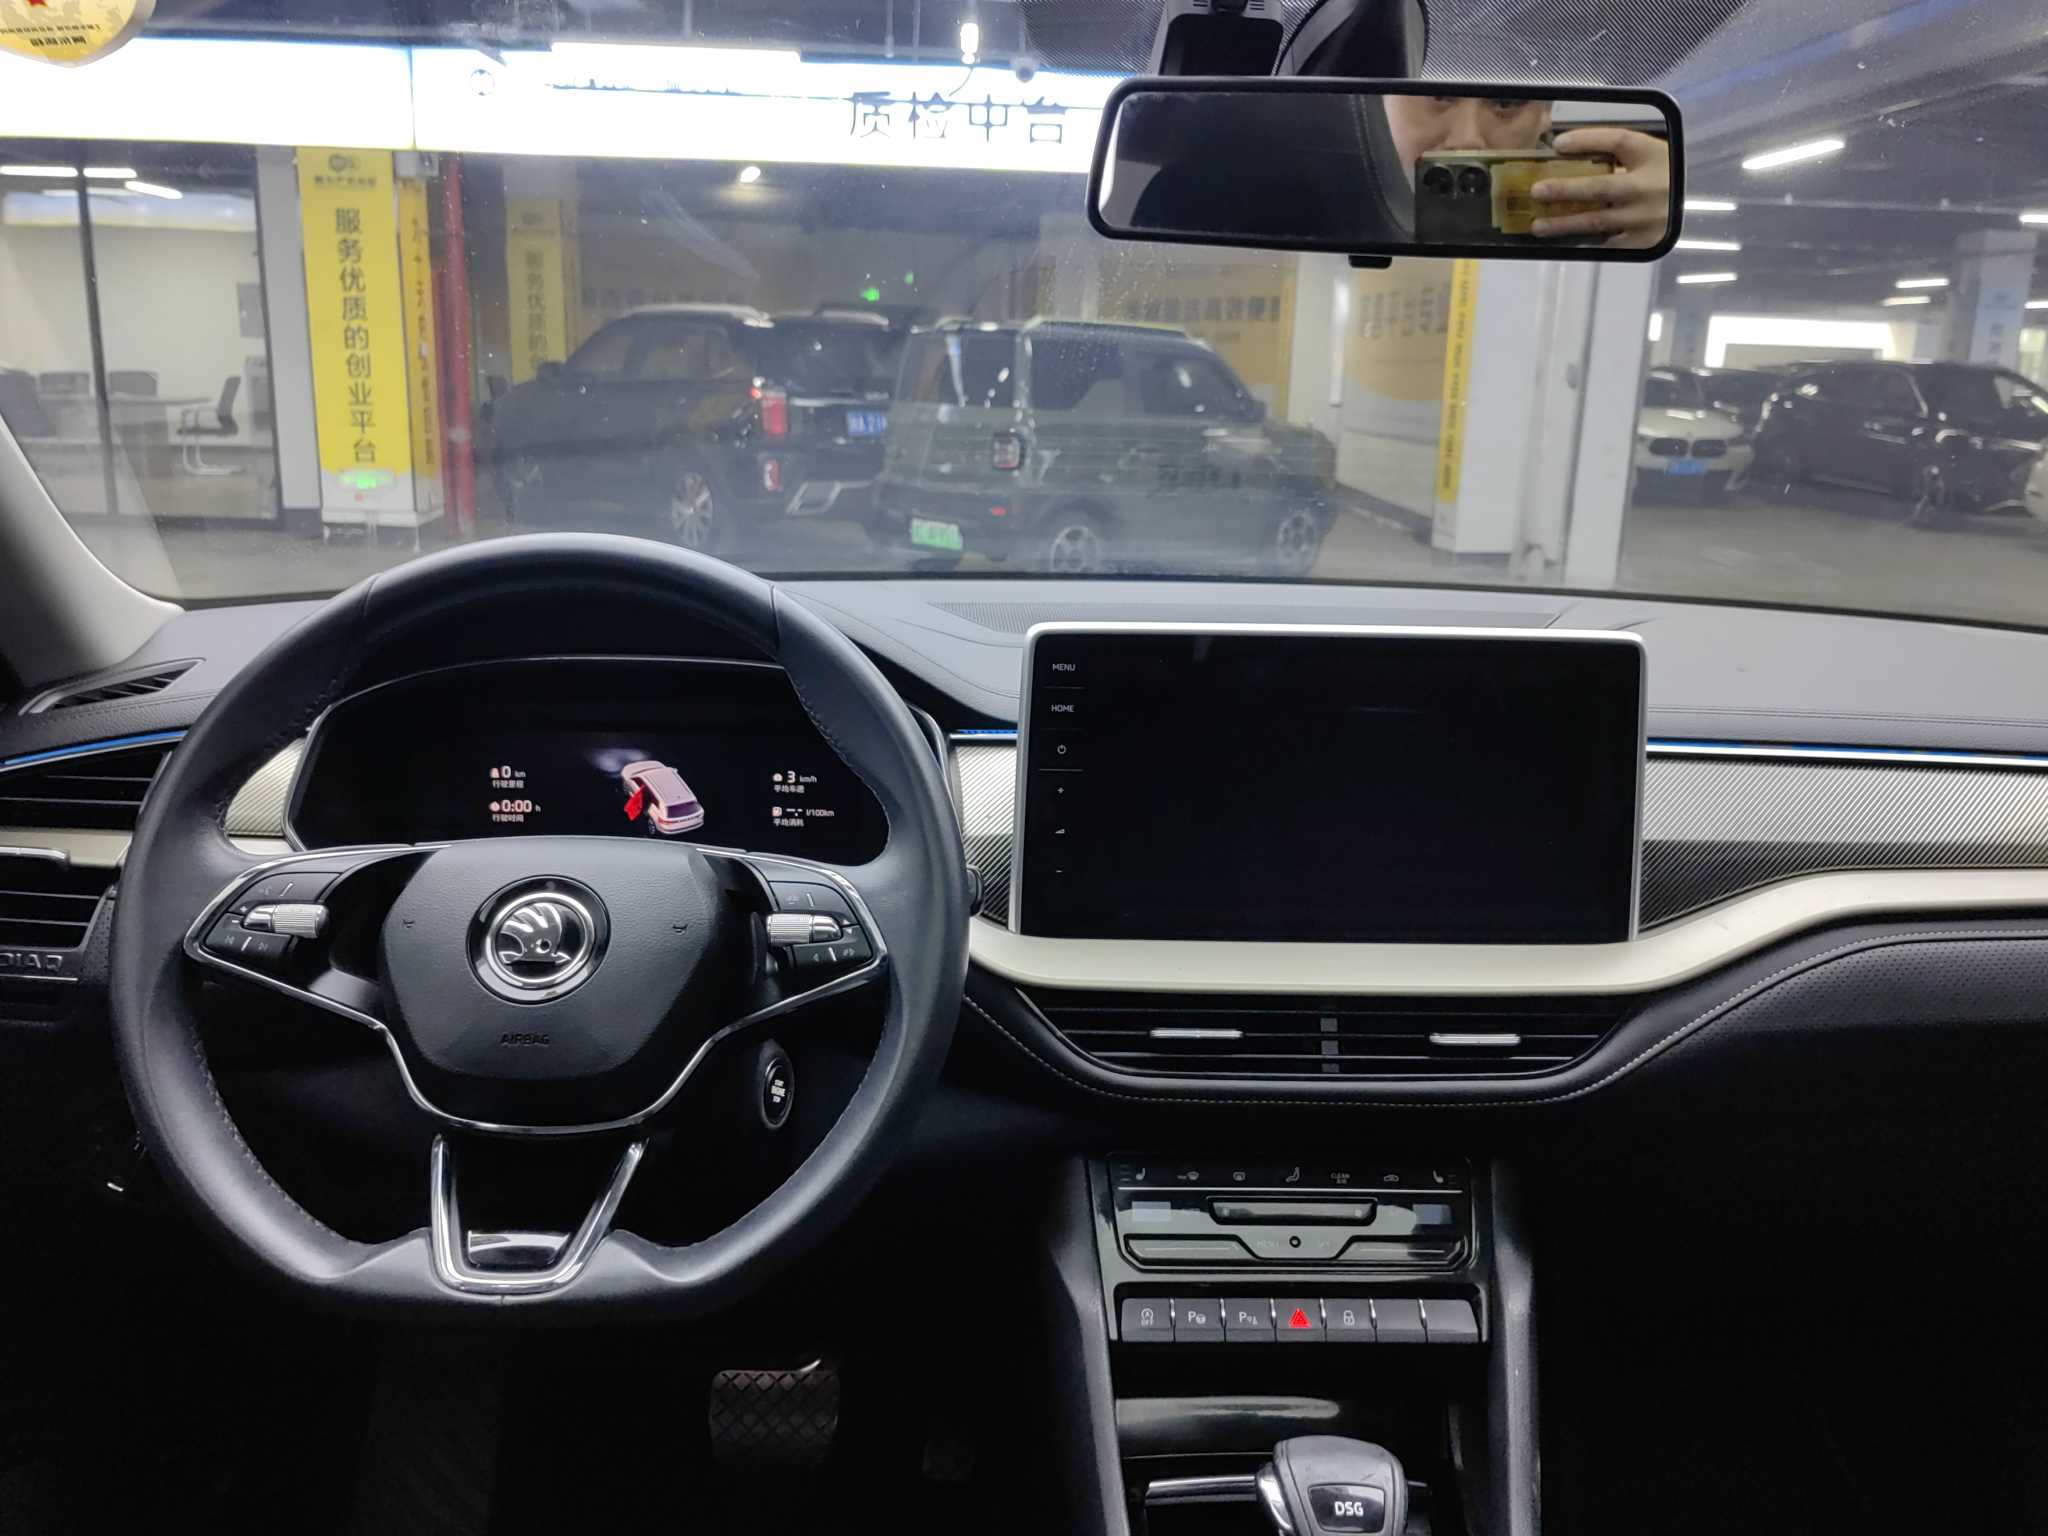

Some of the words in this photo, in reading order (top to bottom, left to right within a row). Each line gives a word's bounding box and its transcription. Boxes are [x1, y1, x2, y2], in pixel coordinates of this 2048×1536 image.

[850, 91, 1067, 144] 质检中台
[336, 207, 376, 463] 服务优质的创业平台
[1052, 663, 1076, 671] MENU
[1050, 704, 1075, 712] HOME
[501, 766, 511, 778] 0
[787, 770, 796, 783] 3
[799, 775, 818, 783] km/h
[492, 780, 525, 788] 行驶里程
[774, 784, 805, 793] 平均车速
[501, 799, 532, 812] 0:00
[492, 814, 525, 822] 行驶时间
[774, 818, 805, 826] 平均消耗
[500, 1032, 550, 1047] AIRBAG
[1334, 1501, 1364, 1517] DSG
